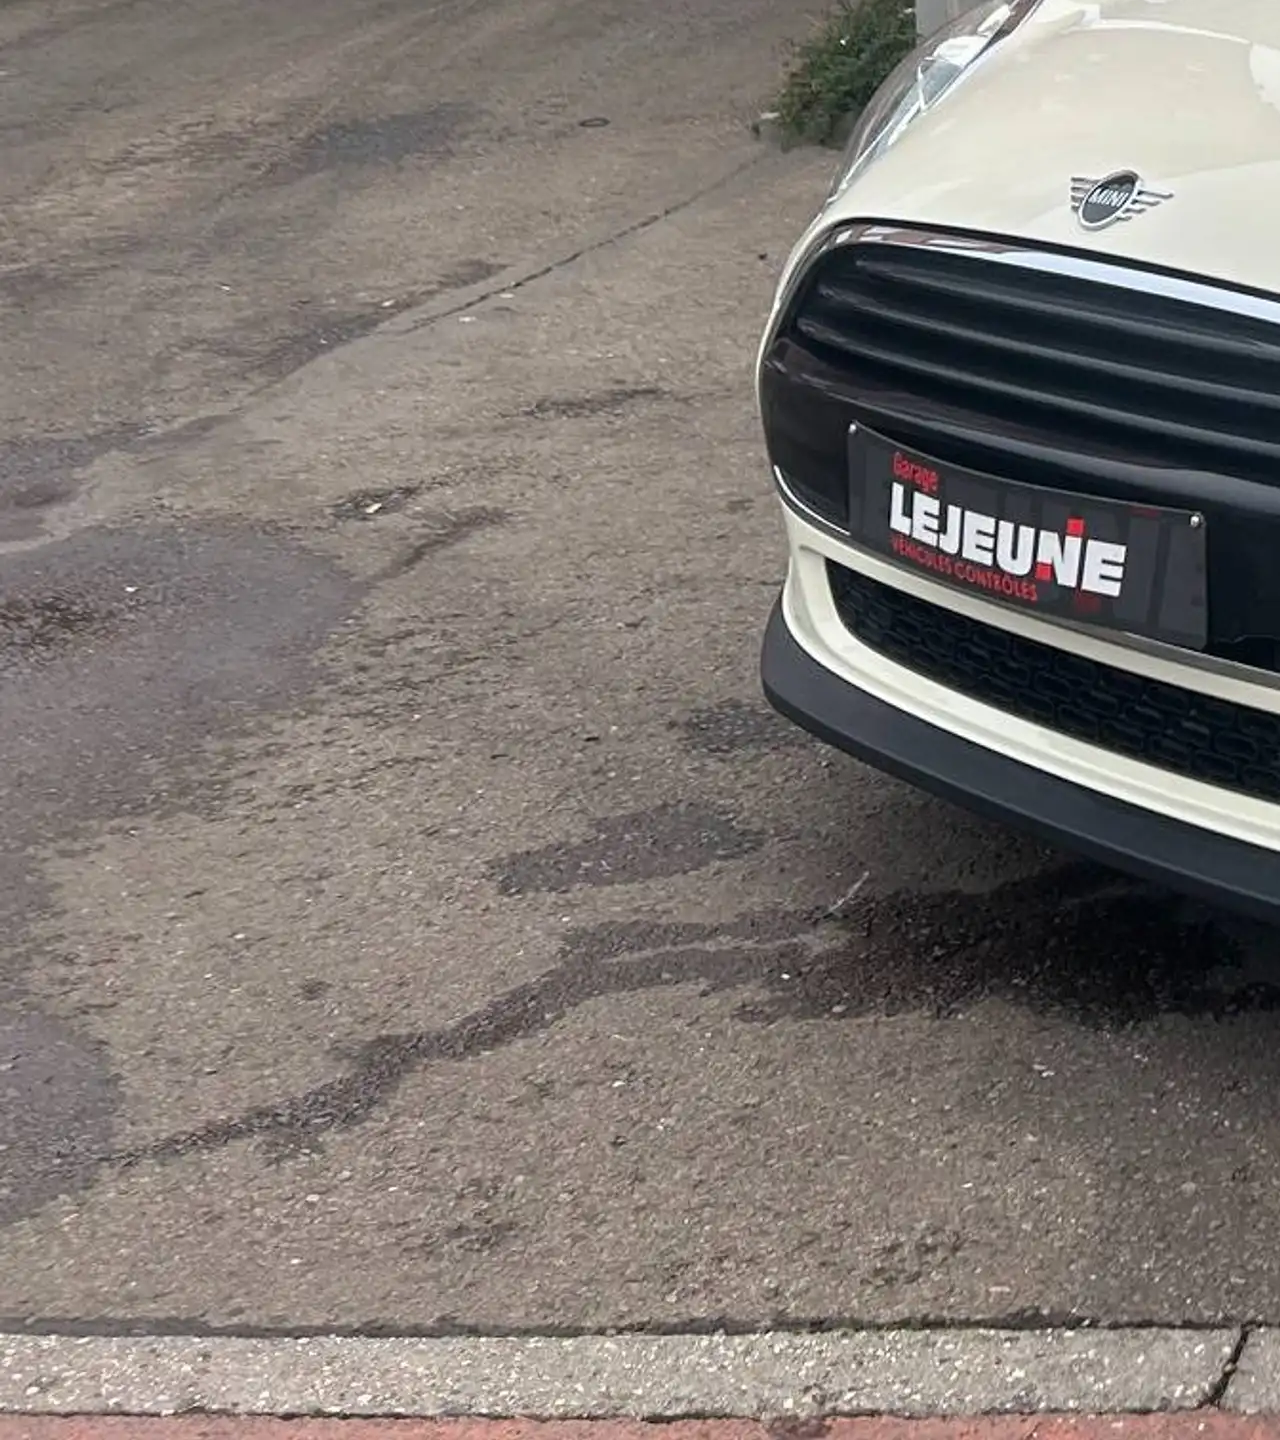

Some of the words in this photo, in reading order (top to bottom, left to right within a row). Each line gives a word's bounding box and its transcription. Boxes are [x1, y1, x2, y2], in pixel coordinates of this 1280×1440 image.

[1087, 188, 1129, 207] MINI
[892, 451, 939, 493] Garage
[889, 481, 1127, 598] LEJEUNE
